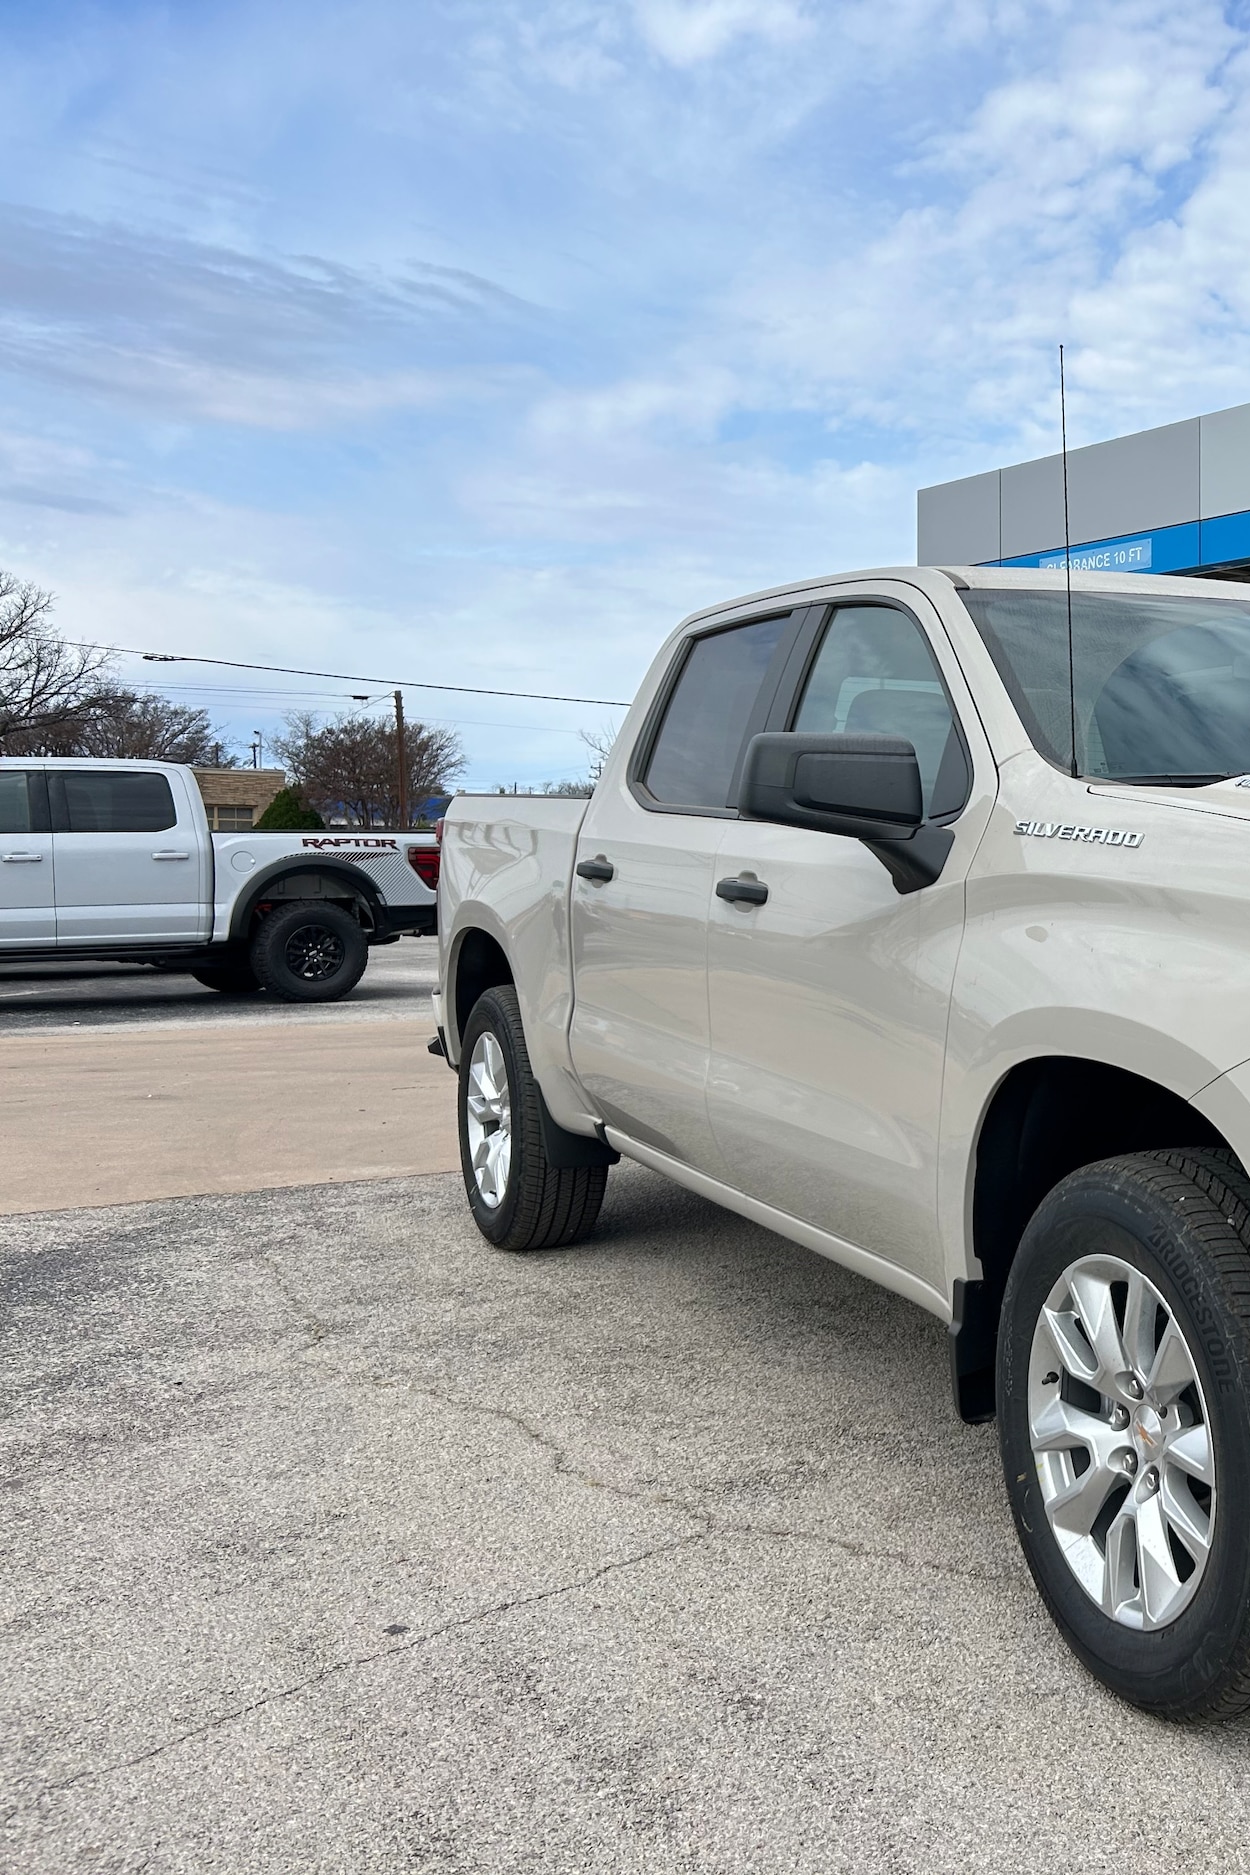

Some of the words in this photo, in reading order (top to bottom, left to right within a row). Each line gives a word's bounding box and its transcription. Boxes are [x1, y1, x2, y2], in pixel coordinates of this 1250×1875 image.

[1114, 551, 1126, 565] 10
[1128, 547, 1143, 562] FT
[302, 838, 401, 851] RAPTOR
[1013, 820, 1145, 848] SILVERADO
[1147, 1219, 1237, 1394] BRIDGESTONE
